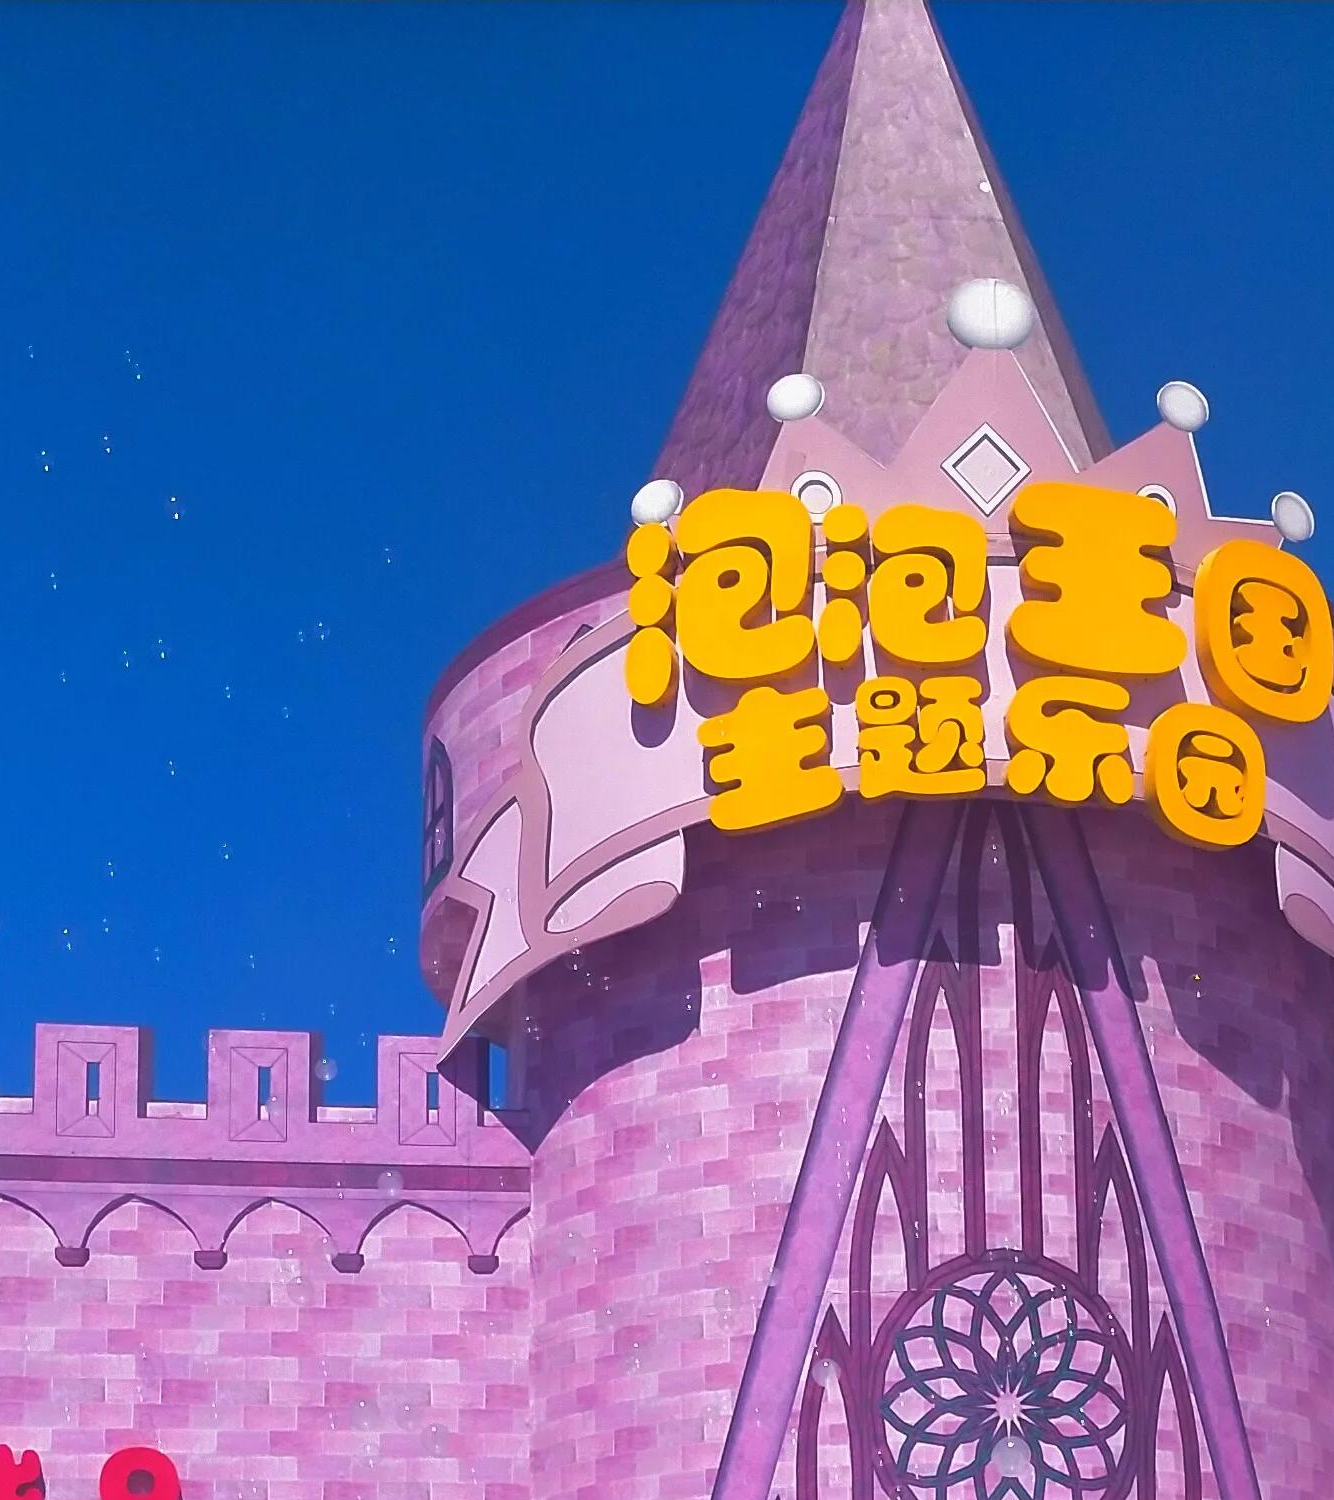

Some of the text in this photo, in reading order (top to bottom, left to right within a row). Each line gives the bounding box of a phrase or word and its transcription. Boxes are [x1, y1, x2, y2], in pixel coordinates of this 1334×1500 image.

[624, 481, 1334, 724] 泡泡王国
[696, 674, 1267, 849] 主题乐园
